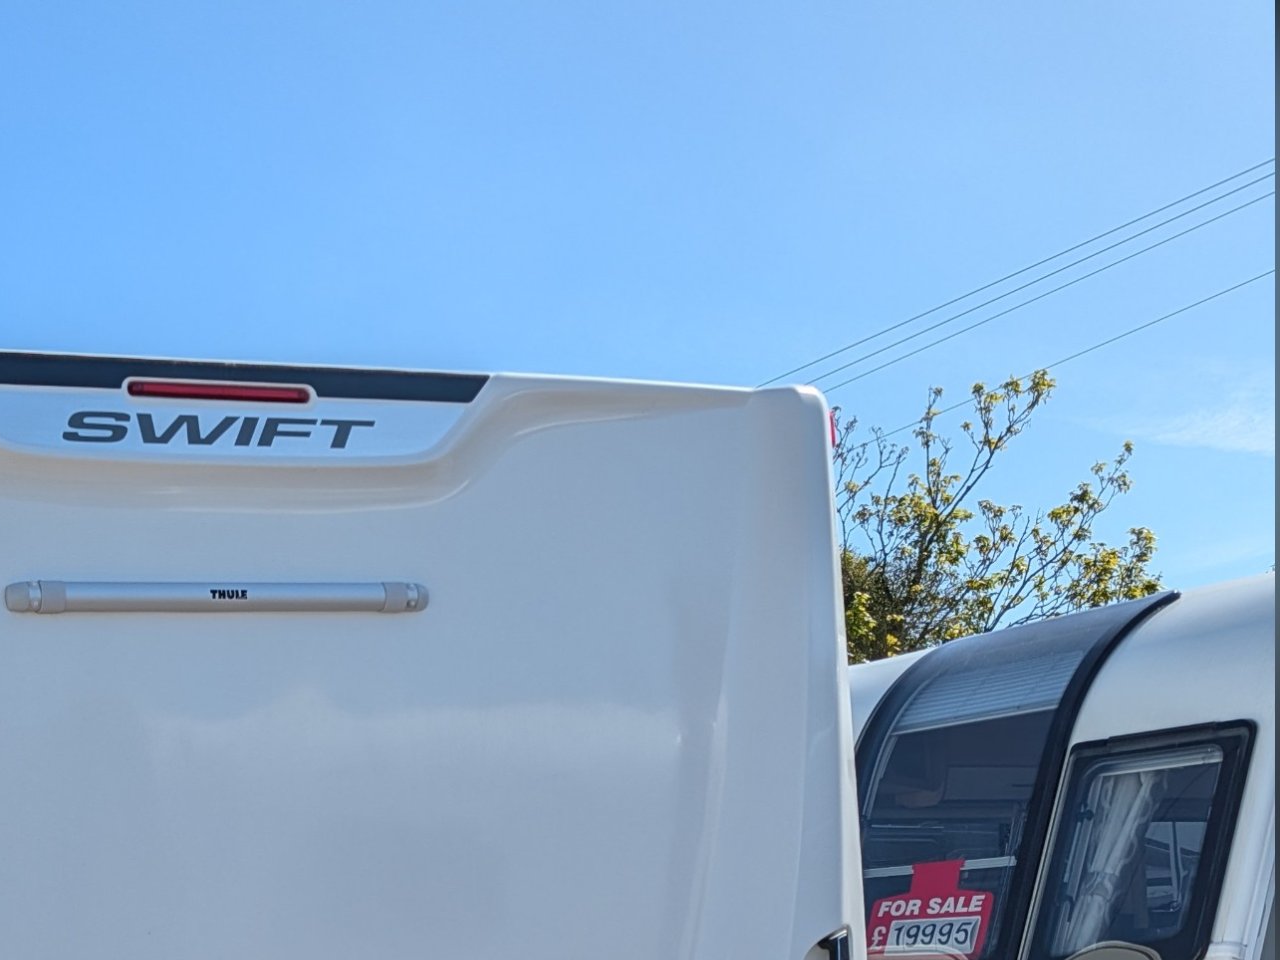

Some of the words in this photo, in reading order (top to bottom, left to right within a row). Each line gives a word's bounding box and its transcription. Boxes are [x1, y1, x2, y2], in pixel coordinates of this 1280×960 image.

[62, 410, 376, 450] SWIFT
[210, 589, 248, 600] THULE
[877, 899, 922, 918] FOR
[926, 894, 986, 915] SALE
[894, 922, 973, 947] 19995
